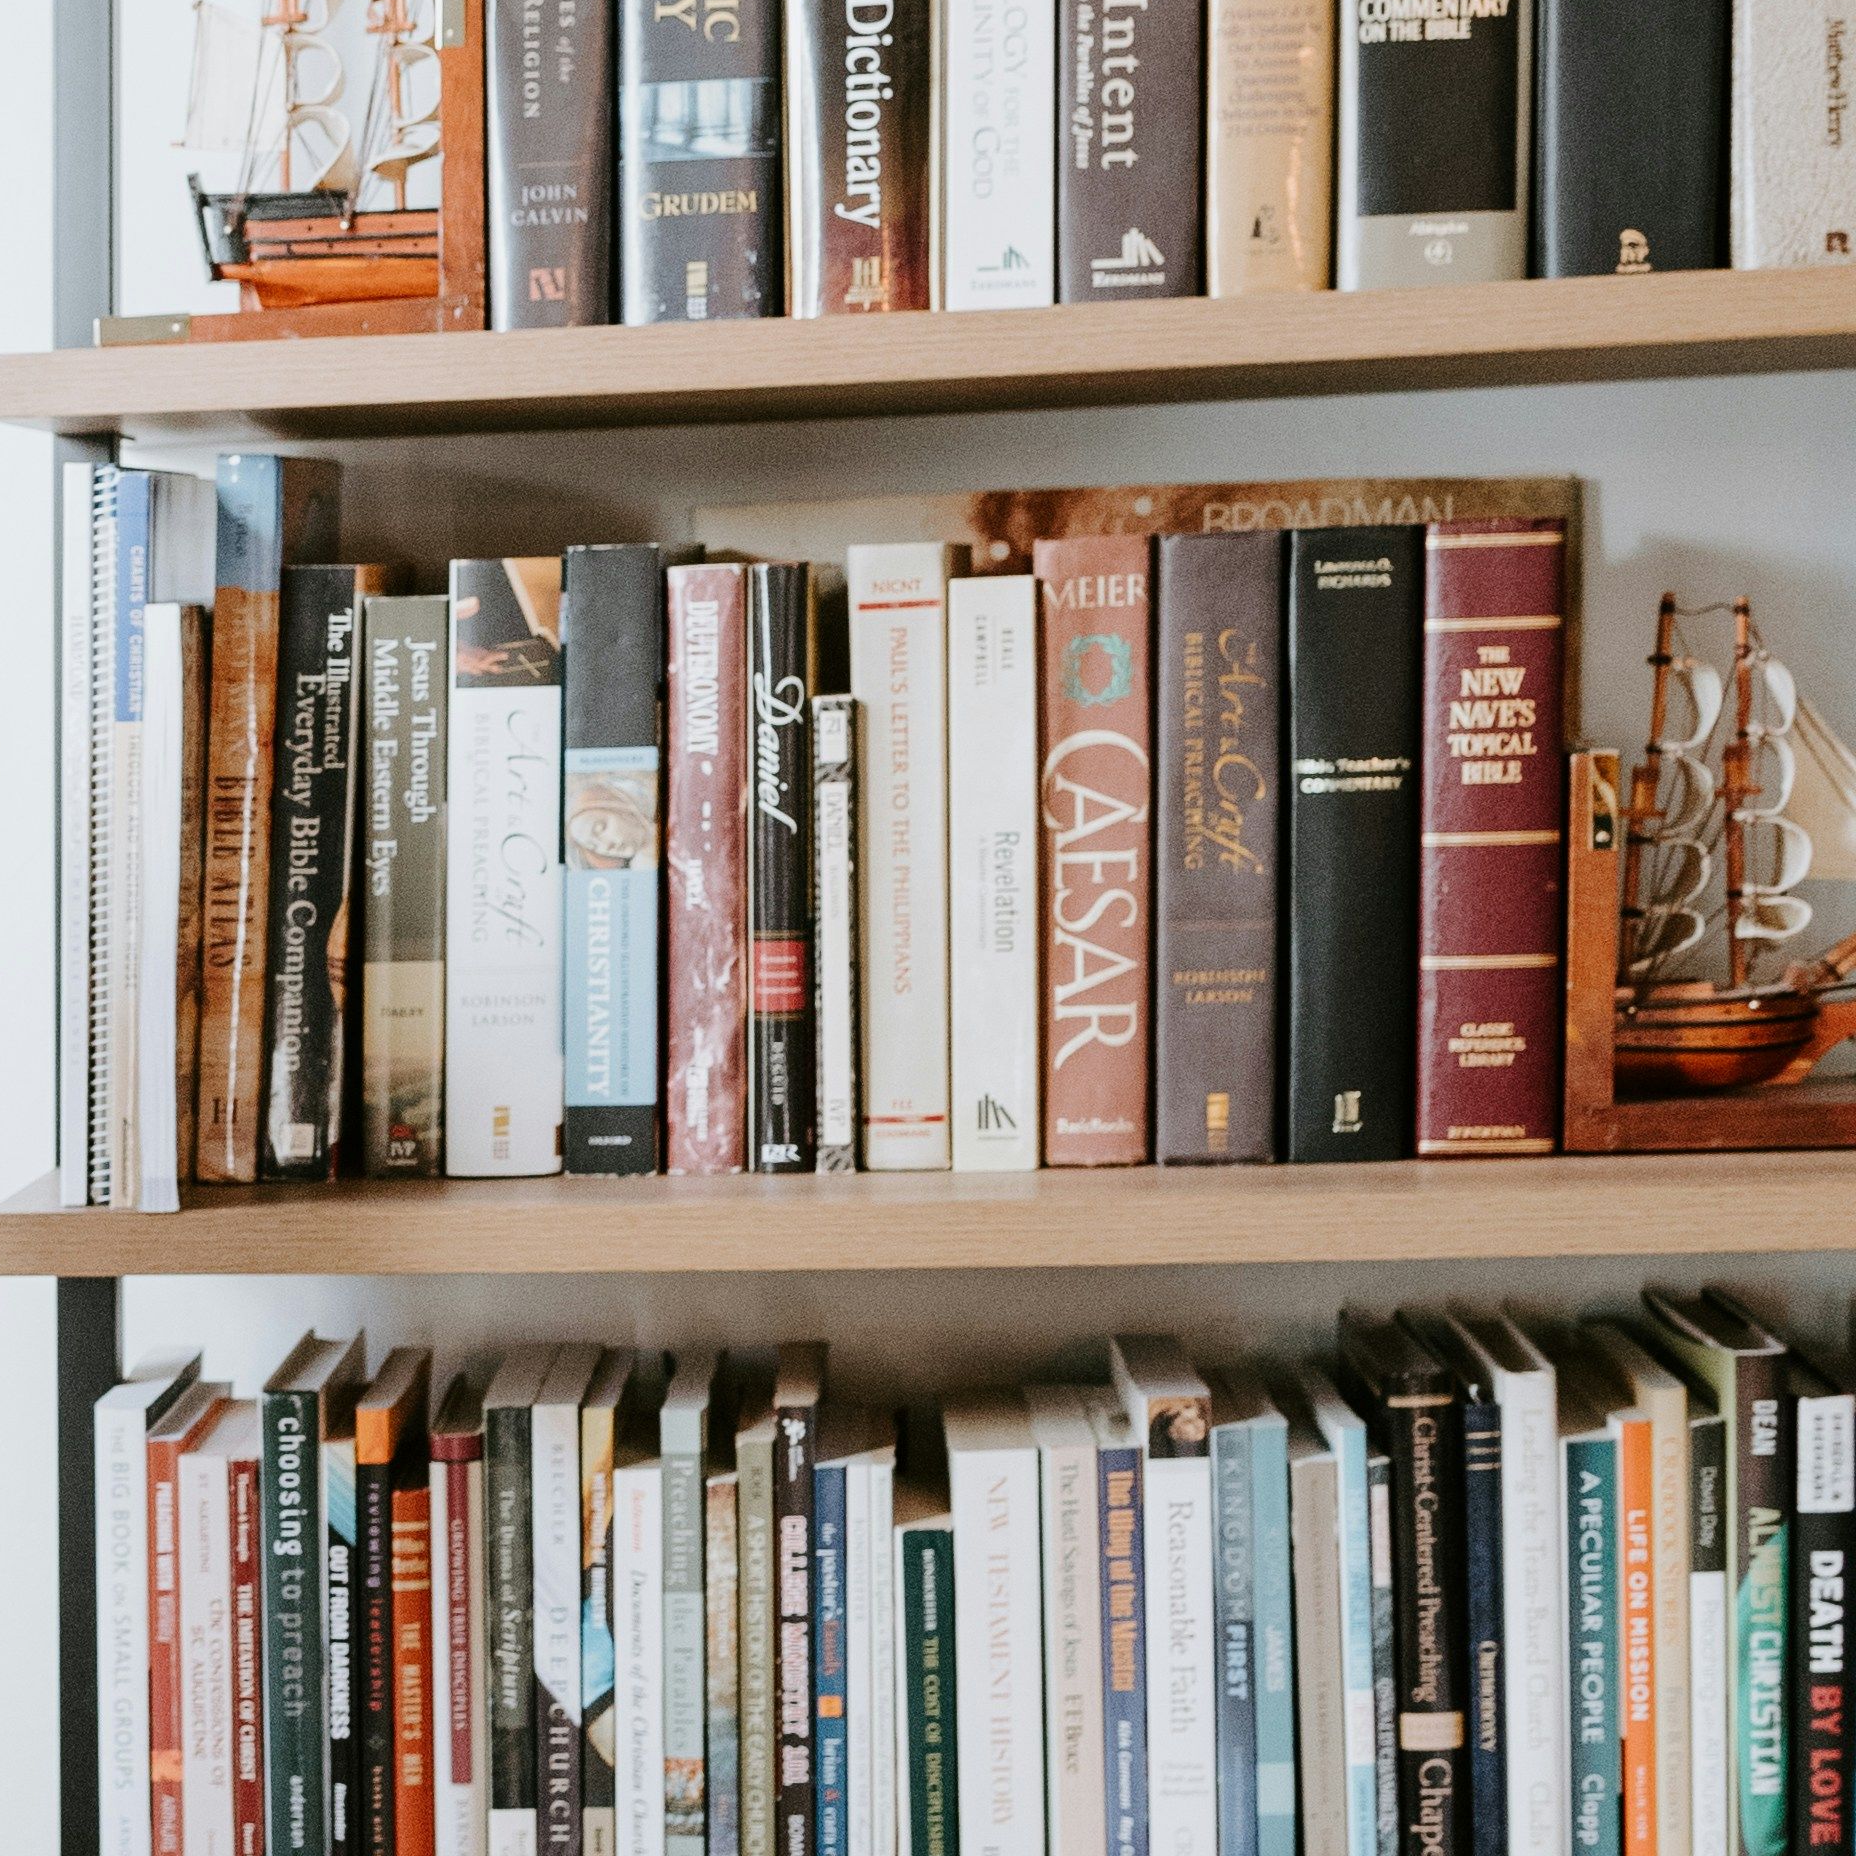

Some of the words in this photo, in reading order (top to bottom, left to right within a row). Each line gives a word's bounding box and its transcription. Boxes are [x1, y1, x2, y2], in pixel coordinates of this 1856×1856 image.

[1077, 4, 1096, 29] the
[1359, 20, 1385, 43] ON
[1388, 19, 1420, 42] THE
[1423, 18, 1472, 41] BIBLE
[972, 90, 991, 120] OF
[1075, 33, 1094, 102] Parables
[1070, 106, 1093, 123] of
[1070, 125, 1093, 170] Jesus
[520, 185, 578, 201] JOHN
[970, 124, 1000, 200] GOD
[510, 208, 589, 226] CALVIN
[637, 190, 757, 222] GRUDEM
[324, 608, 353, 653] The
[1044, 573, 1146, 612] MEIER
[370, 638, 399, 732] Middle
[403, 638, 437, 701] Jesus
[685, 600, 720, 756] DEUTERONOMY
[889, 627, 911, 694] PAUL'S
[1459, 666, 1526, 700] NEW
[1477, 645, 1511, 663] THE
[281, 671, 328, 807] Everyday
[321, 657, 350, 769] Illustrated
[889, 701, 911, 775] LETTER
[1446, 731, 1537, 758] TOPICAL
[1448, 698, 1537, 730] NAVE'S
[368, 738, 397, 832] Eastern
[403, 707, 437, 824] Through
[753, 672, 806, 835] Daniel
[1460, 758, 1523, 786] BIBLE
[211, 774, 261, 861] BIBLE
[892, 781, 911, 812] TO
[286, 815, 321, 892] Bible
[367, 838, 396, 897] Eyes
[891, 818, 912, 859] THE
[207, 873, 257, 971] ATLAS
[994, 829, 1021, 955] Revelation
[1041, 726, 1153, 1071] CAESAR
[891, 864, 913, 997] PHILIPPIANS
[277, 899, 318, 1072] Companion
[583, 876, 611, 1098] CHRISTIANITY
[1750, 1399, 1778, 1456] DEAN
[264, 1417, 308, 1557] choosing
[985, 1476, 1009, 1534] NEW
[1412, 1416, 1438, 1595] Christ-Centered
[1578, 1470, 1603, 1494] A
[666, 1456, 696, 1586] Preaching
[1627, 1509, 1646, 1559] LIFE
[279, 1568, 307, 1600] to
[329, 1544, 349, 1587] OUT
[1165, 1500, 1194, 1655] Reasonable
[1579, 1498, 1604, 1632] PECULIAR
[1627, 1570, 1649, 1608] ON
[1748, 1506, 1781, 1626] ALMOST
[329, 1589, 349, 1640] FROM
[671, 1597, 695, 1638] the
[986, 1551, 1010, 1701] TESTAMENT
[1808, 1550, 1842, 1672] DEATH
[273, 1612, 312, 1719] preach
[494, 1607, 524, 1709] Scripture
[547, 1606, 572, 1695] DEEP
[1412, 1597, 1442, 1703] Preaching
[1628, 1616, 1650, 1721] MISSION
[329, 1642, 350, 1740] DARKNESS
[671, 1645, 697, 1753] Parables
[1169, 1665, 1197, 1734] Faith
[1580, 1641, 1606, 1745] PEOPLE
[1749, 1630, 1784, 1796] CHRISTIAN
[1810, 1684, 1839, 1738] BY
[547, 1701, 572, 1844] CHURCH
[987, 1715, 1013, 1827] HISTORY
[1809, 1749, 1839, 1846] LOVE
[1576, 1773, 1606, 1846] Clapp
